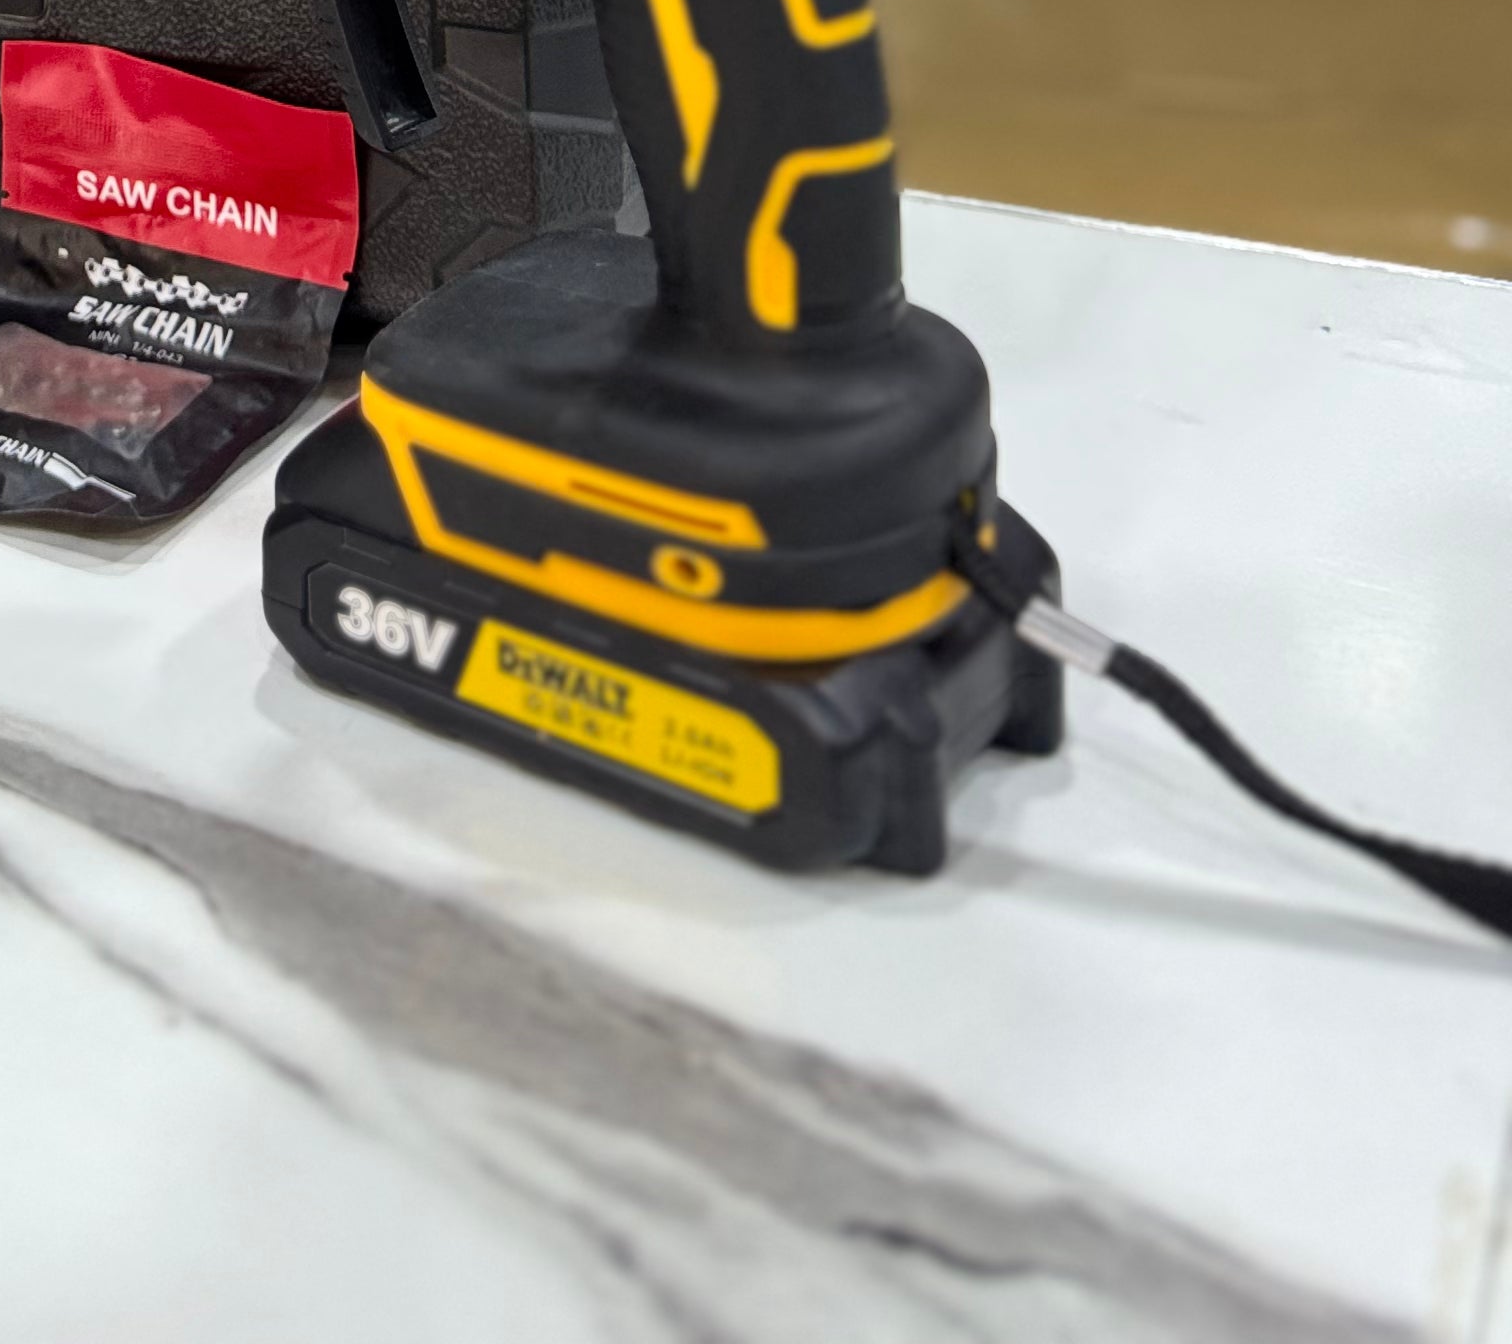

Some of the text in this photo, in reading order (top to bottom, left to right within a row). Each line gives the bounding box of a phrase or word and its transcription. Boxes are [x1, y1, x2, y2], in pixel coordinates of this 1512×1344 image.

[76, 169, 279, 237] SAW CHAIN
[67, 294, 235, 361] SAW CHAIN
[335, 585, 458, 673] 36V
